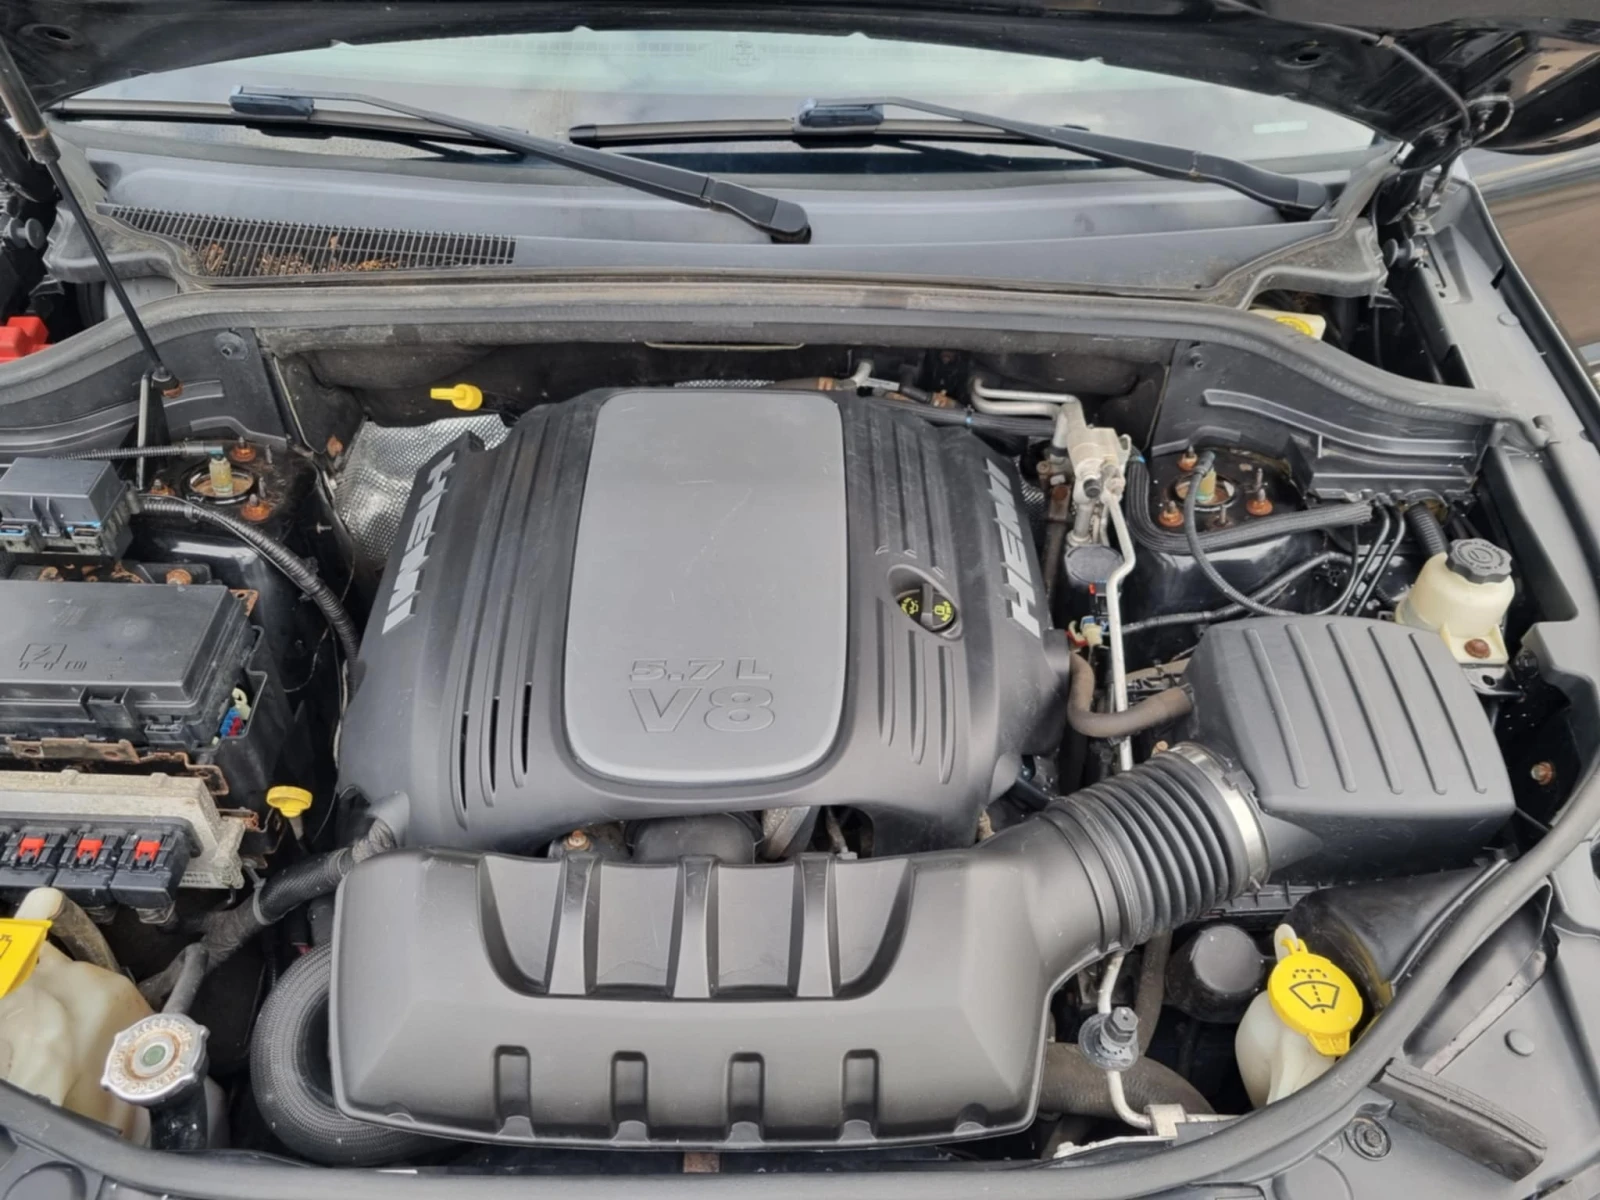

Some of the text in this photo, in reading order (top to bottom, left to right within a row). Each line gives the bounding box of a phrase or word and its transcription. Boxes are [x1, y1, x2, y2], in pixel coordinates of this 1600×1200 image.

[382, 451, 456, 635] HEMI
[983, 457, 1041, 639] HEMI
[628, 685, 776, 733] V8
[629, 657, 725, 681] 5.7
